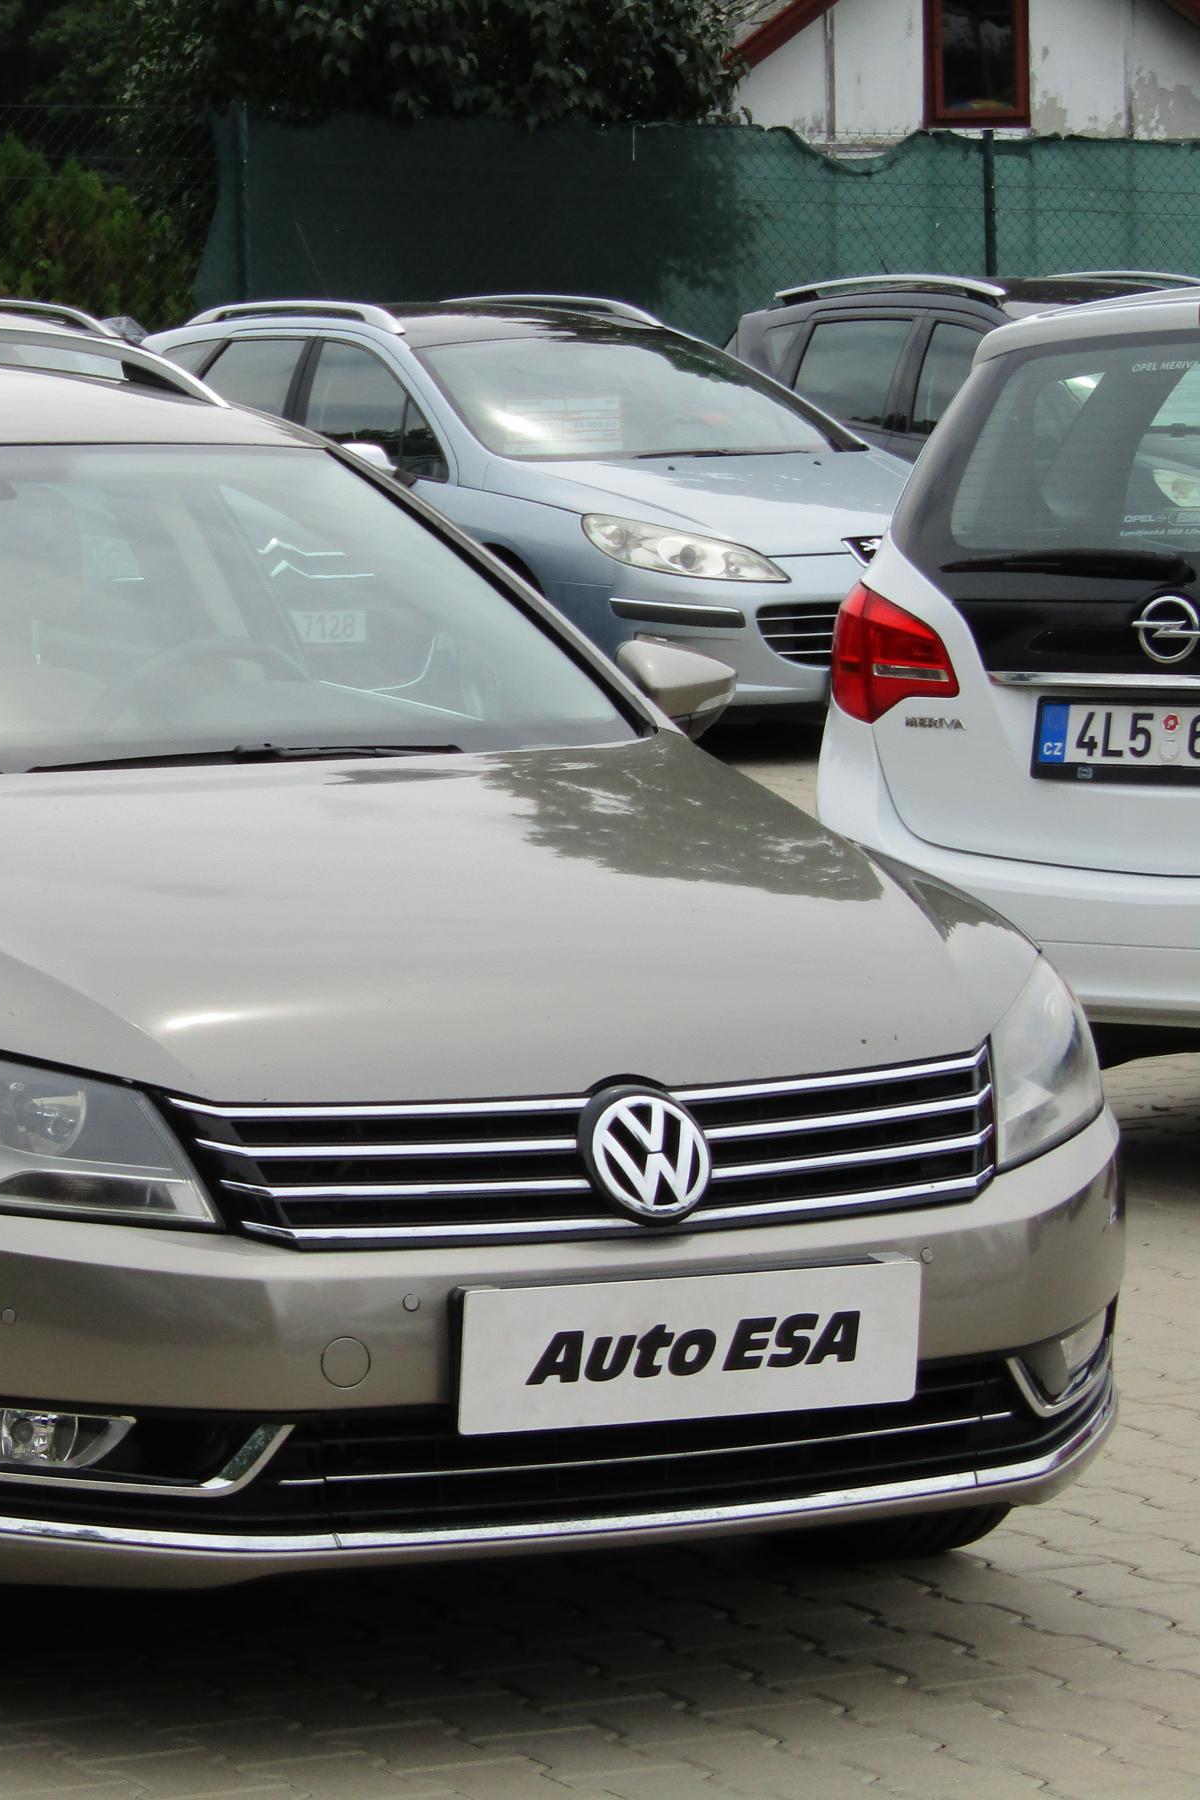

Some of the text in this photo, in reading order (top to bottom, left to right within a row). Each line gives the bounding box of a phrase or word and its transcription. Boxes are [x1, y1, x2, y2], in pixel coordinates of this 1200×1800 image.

[1131, 361, 1158, 373] OPEL
[303, 614, 355, 640] 7128
[905, 716, 967, 731] MERIVA
[1076, 711, 1154, 758] 4L5
[1043, 742, 1063, 756] CZ
[526, 1310, 861, 1385] Auto ESA
